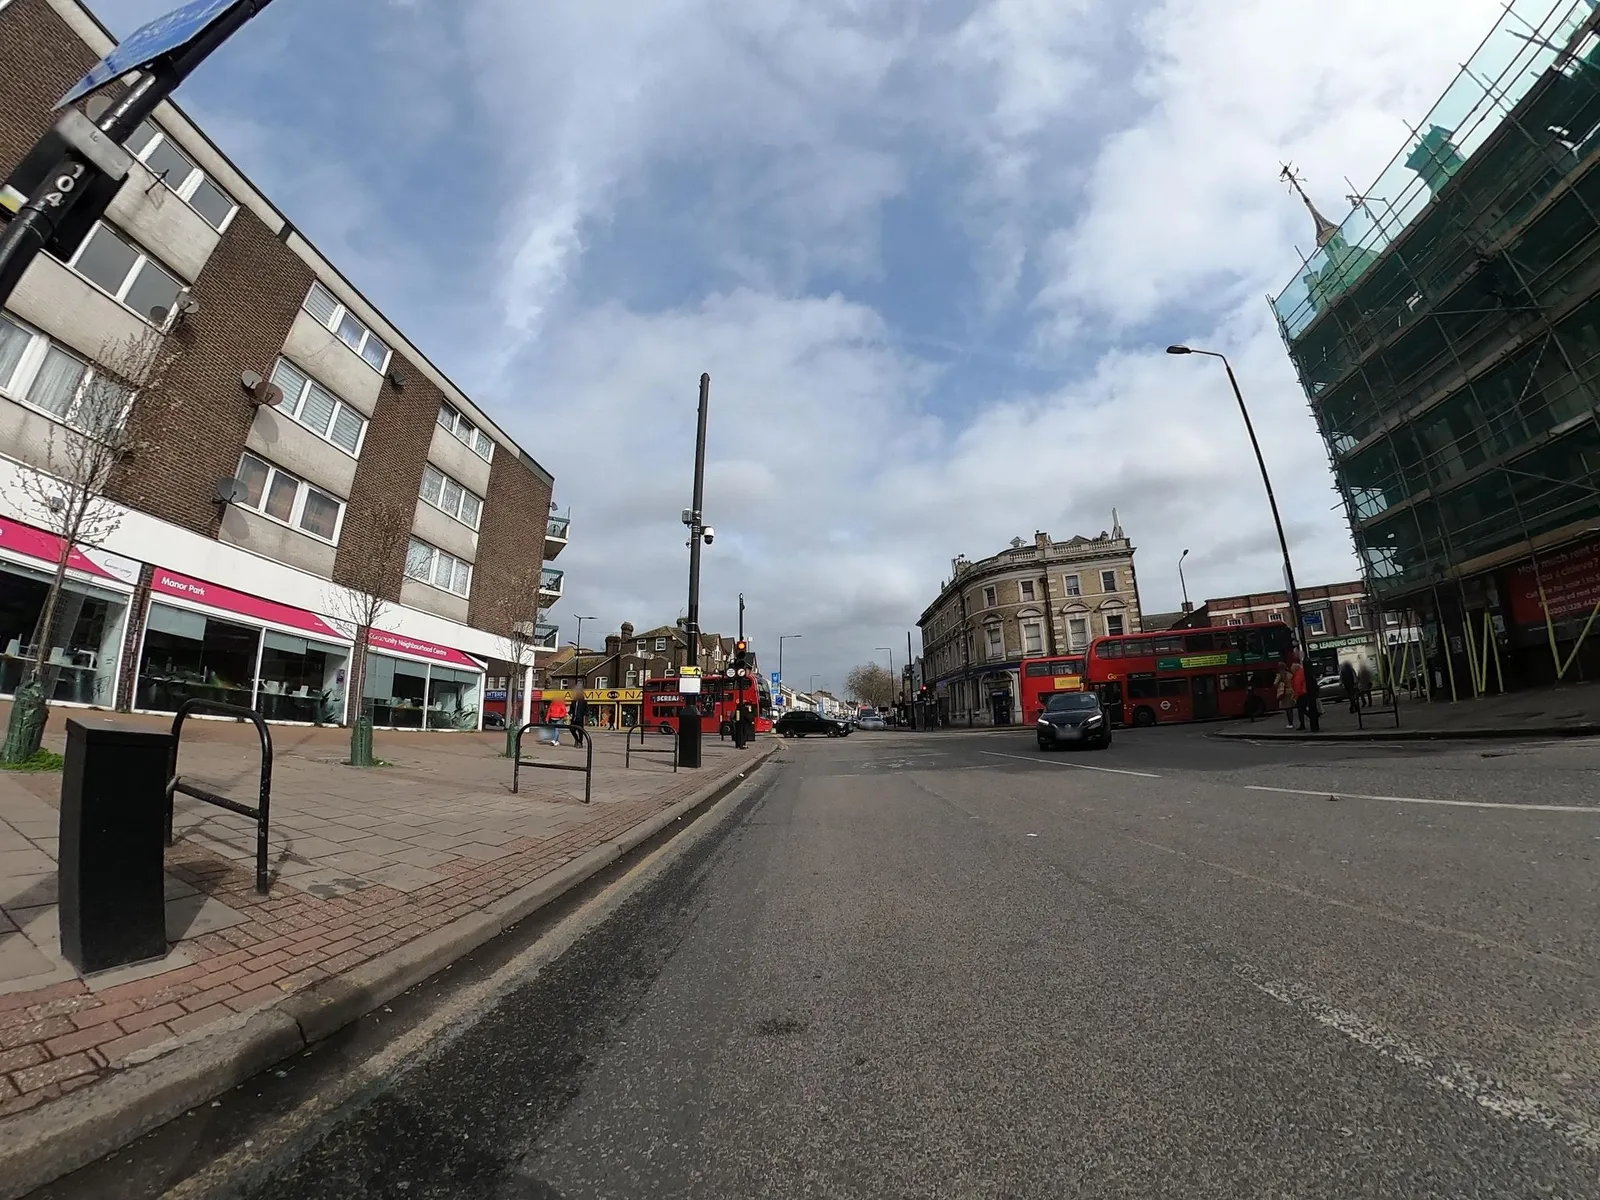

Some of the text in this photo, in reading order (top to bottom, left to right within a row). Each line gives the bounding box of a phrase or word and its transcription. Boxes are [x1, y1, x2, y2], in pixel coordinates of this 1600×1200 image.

[45, 164, 85, 207] 104
[161, 576, 206, 597] Manor Park
[398, 639, 433, 653] Neighbourhood
[433, 647, 447, 656] Centre
[1319, 636, 1368, 649] LEARNING CENTRE
